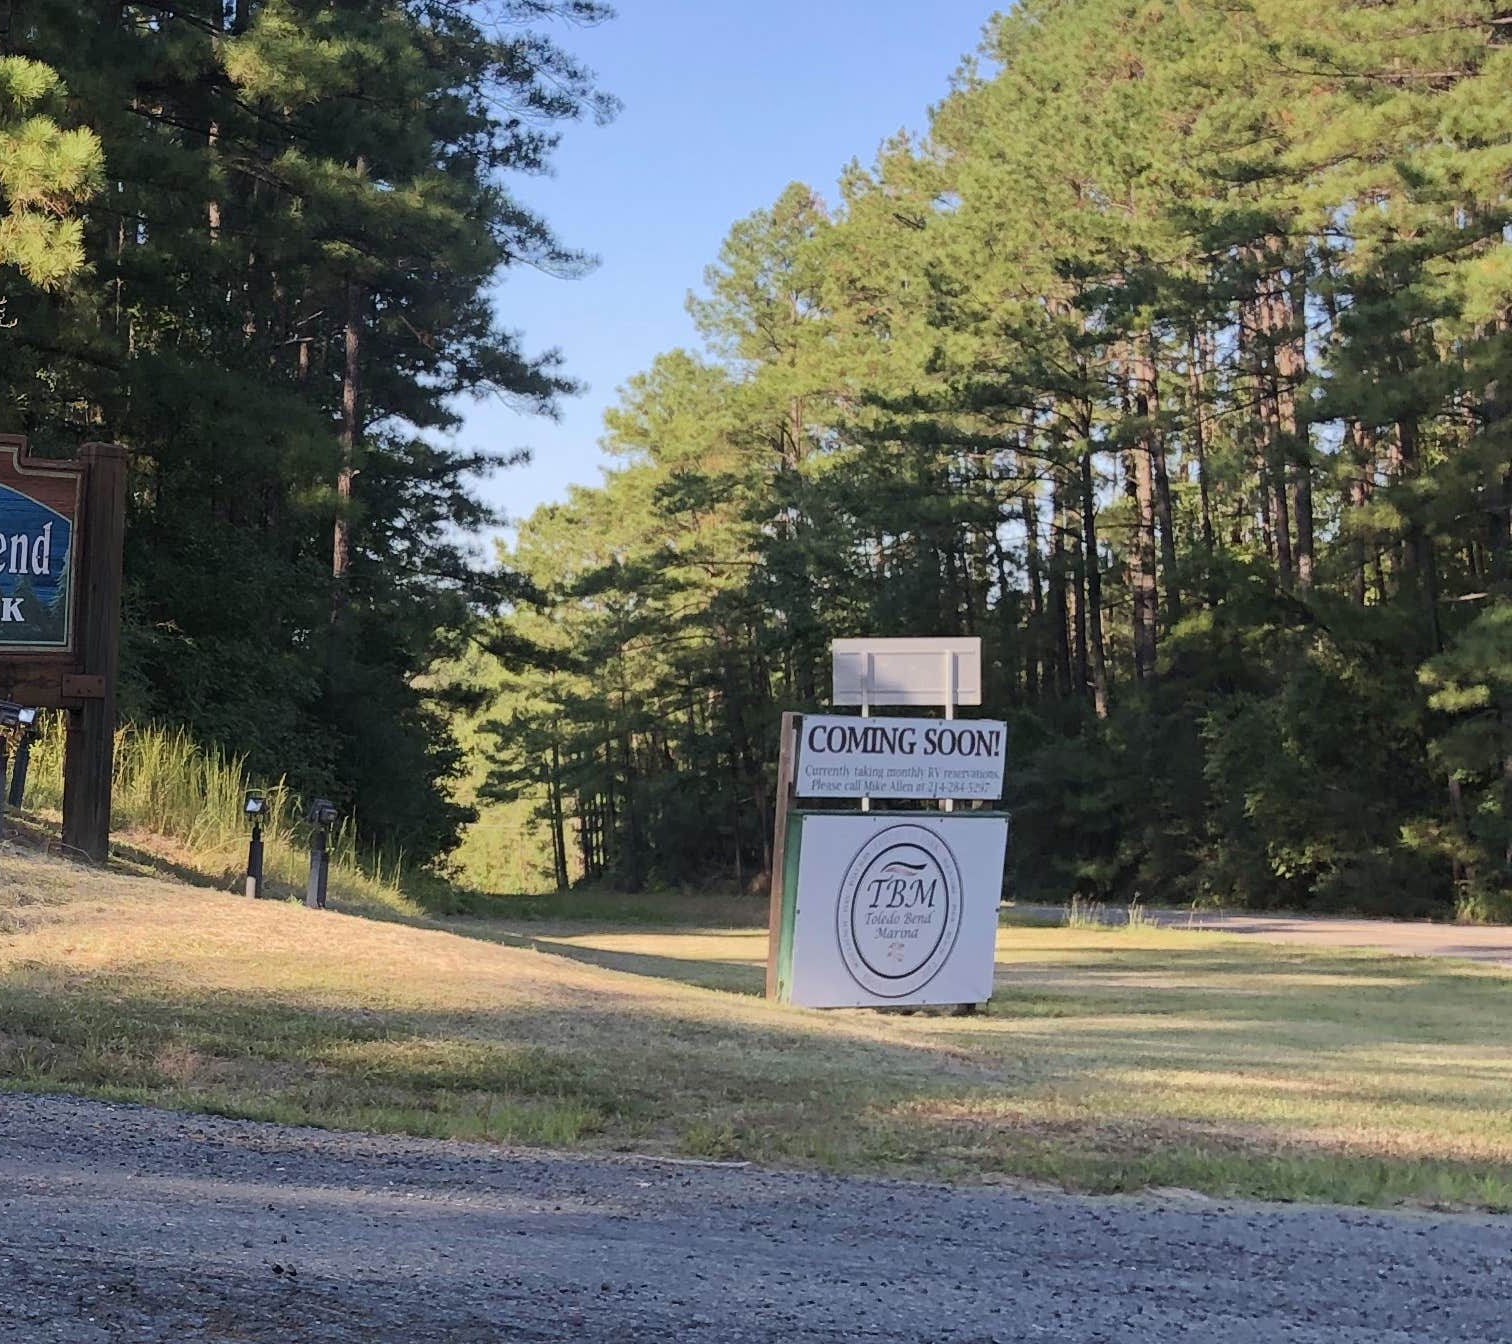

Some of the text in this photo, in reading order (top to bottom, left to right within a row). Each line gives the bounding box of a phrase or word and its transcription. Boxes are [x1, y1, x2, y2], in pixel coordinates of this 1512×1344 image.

[808, 724, 1001, 758] COMING SOON!
[805, 764, 850, 779] Currently
[854, 764, 884, 779] taking
[887, 766, 924, 780] monthly
[811, 778, 842, 792] Please
[844, 779, 861, 792] call
[890, 780, 914, 793] Allen
[867, 876, 937, 909] TBM
[865, 910, 932, 925] Toledo Bend
[874, 927, 919, 940] Marina
